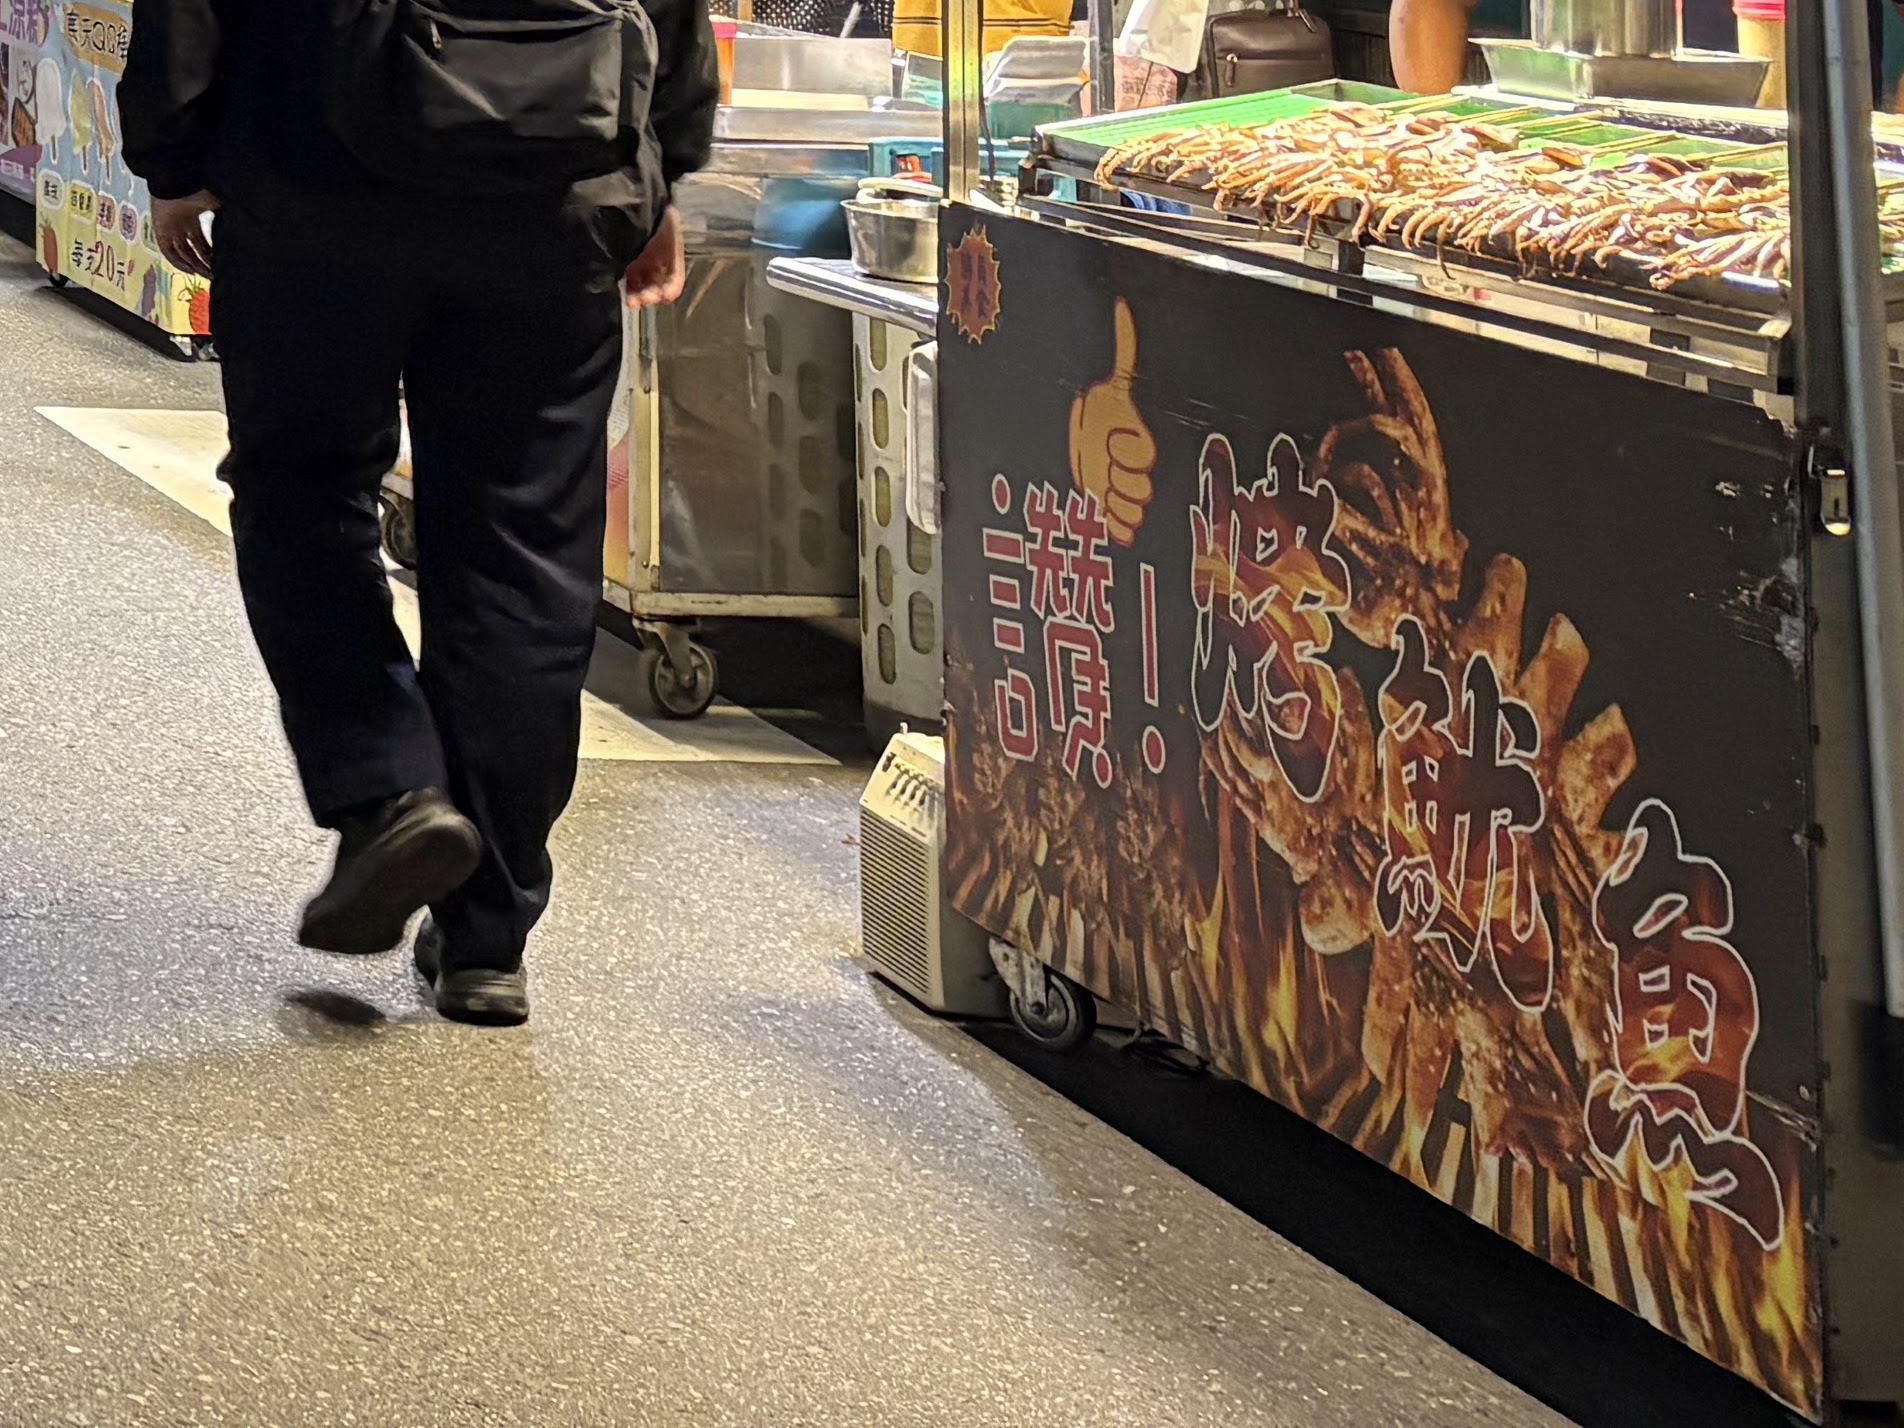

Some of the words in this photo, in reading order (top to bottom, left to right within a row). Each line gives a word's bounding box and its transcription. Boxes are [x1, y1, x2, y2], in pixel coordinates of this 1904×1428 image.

[983, 473, 1168, 788] 讚!
[1191, 433, 1786, 1252] 烤魷魚
